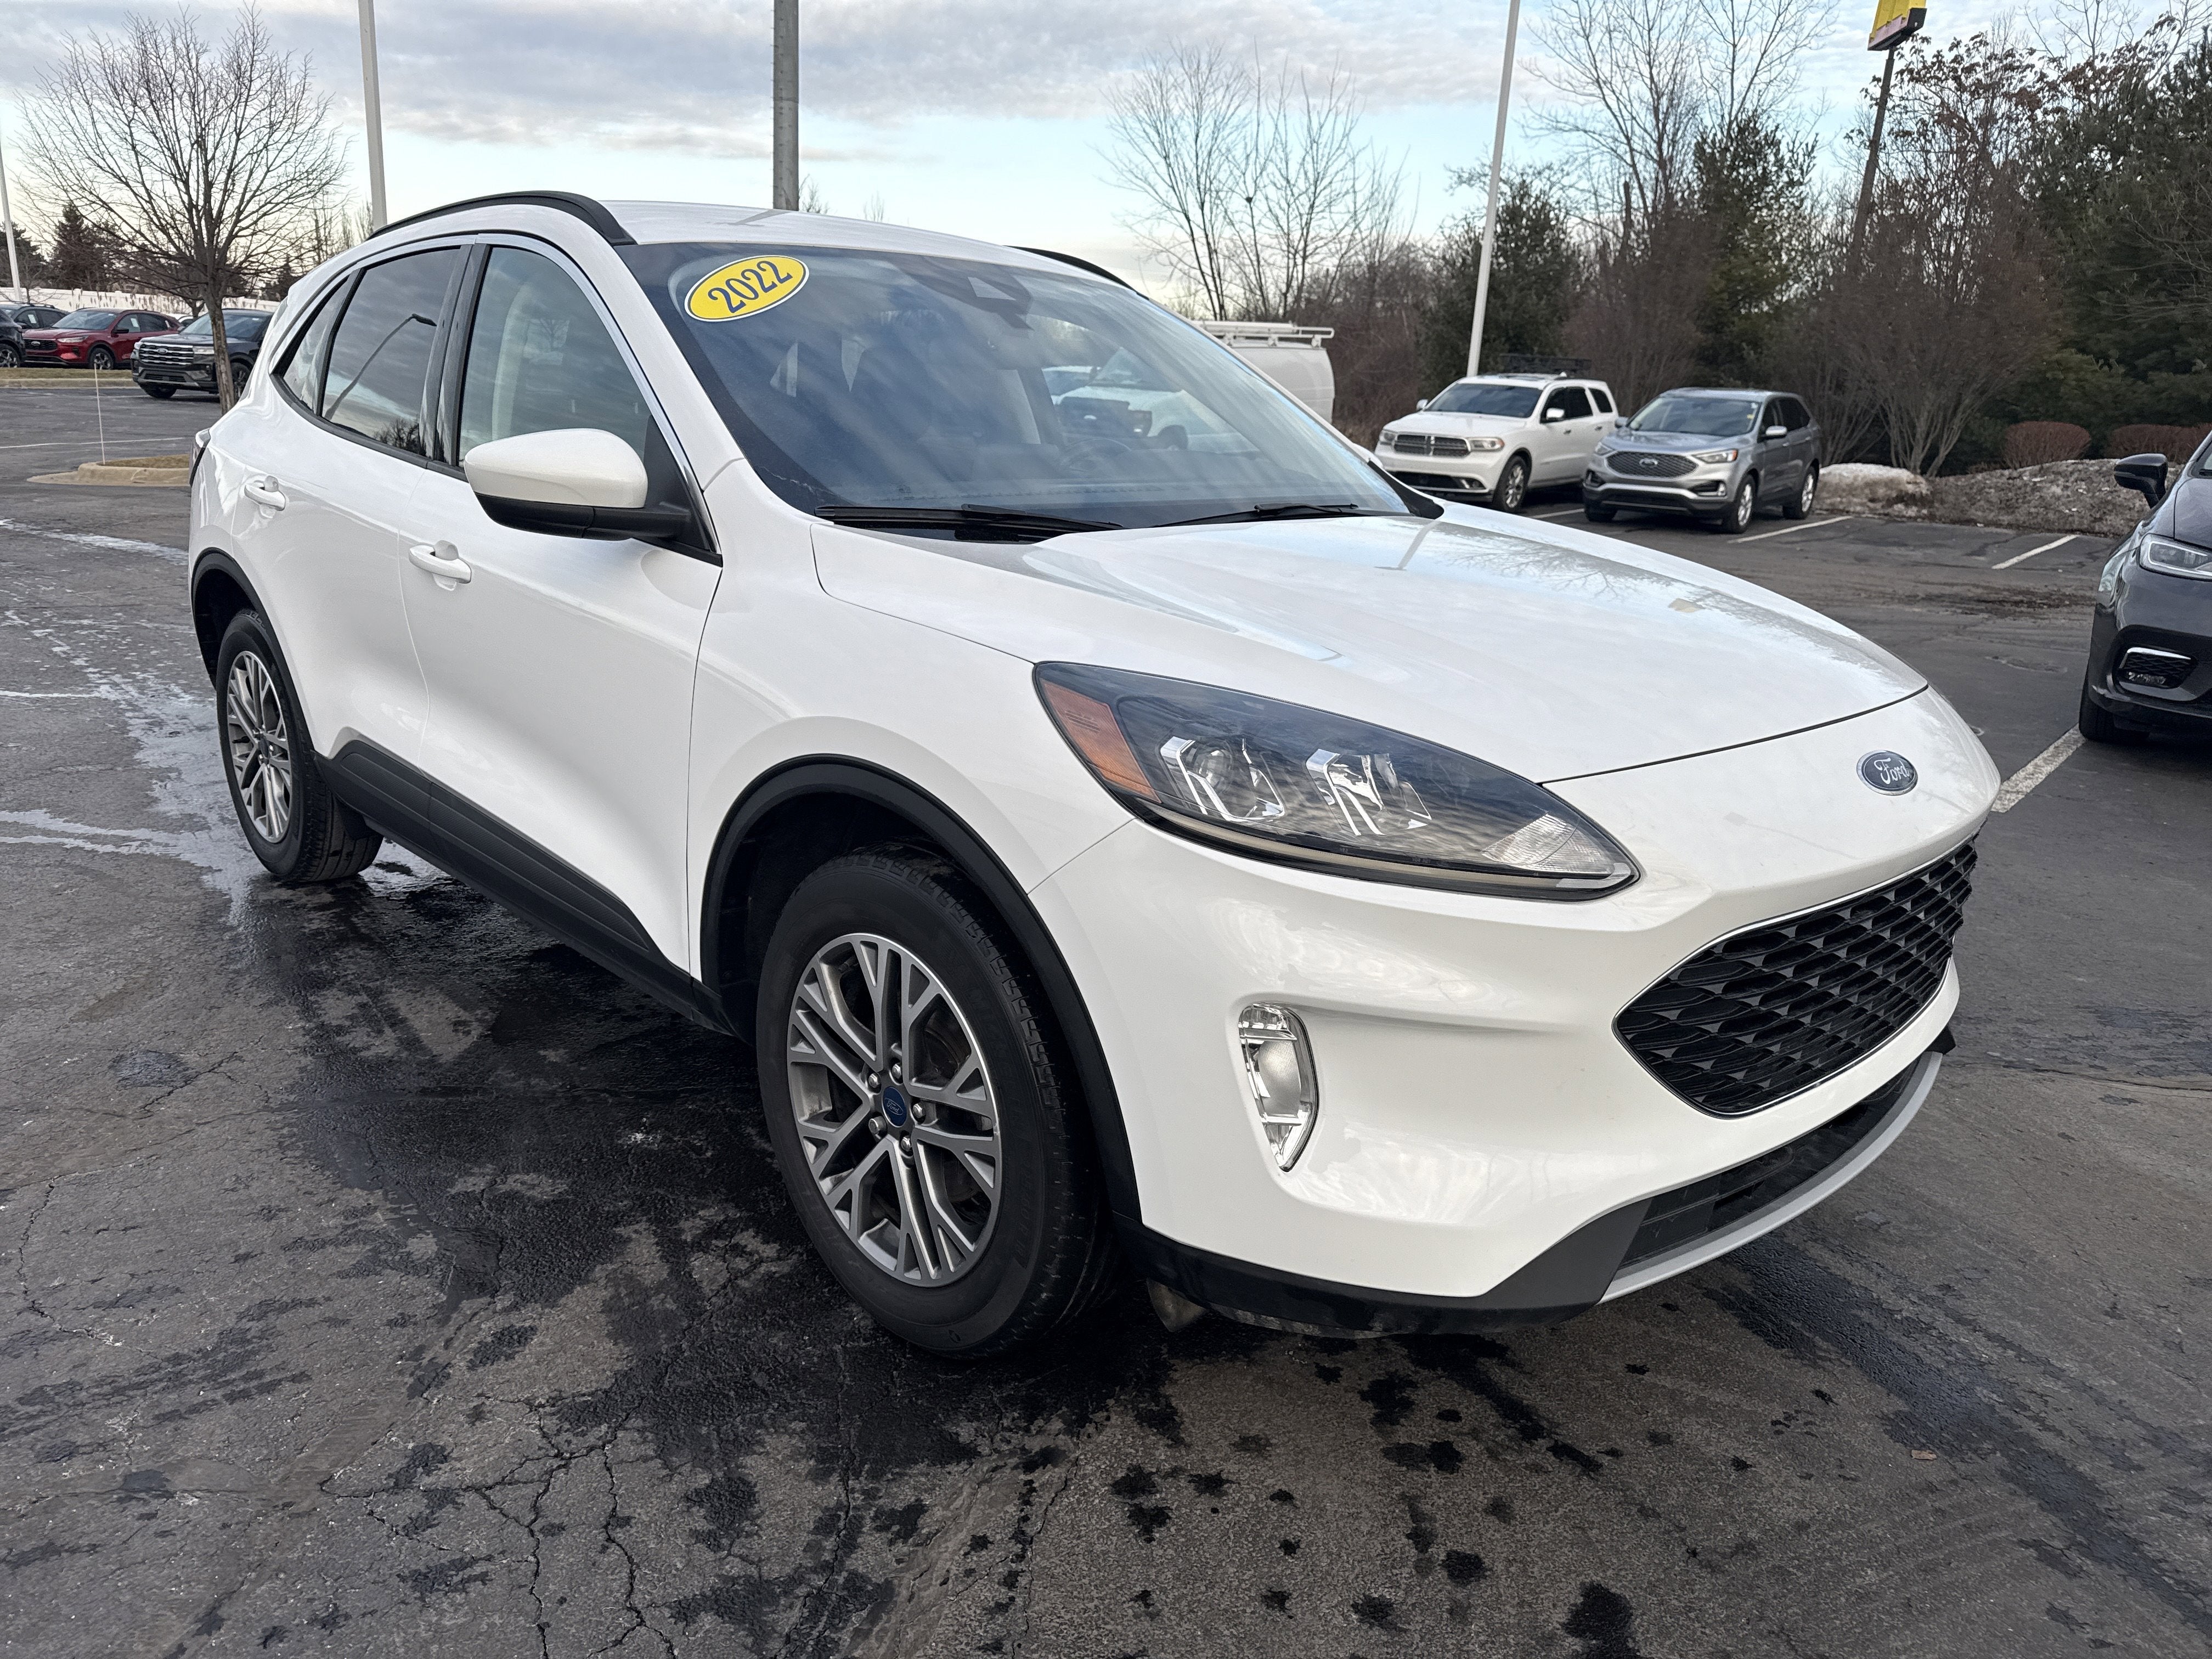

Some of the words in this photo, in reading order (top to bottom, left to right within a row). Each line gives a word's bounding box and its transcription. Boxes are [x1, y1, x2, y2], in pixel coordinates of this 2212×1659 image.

[708, 261, 793, 313] 2022
[1874, 757, 1910, 785] Ford
[886, 1100, 900, 1114] Ford
